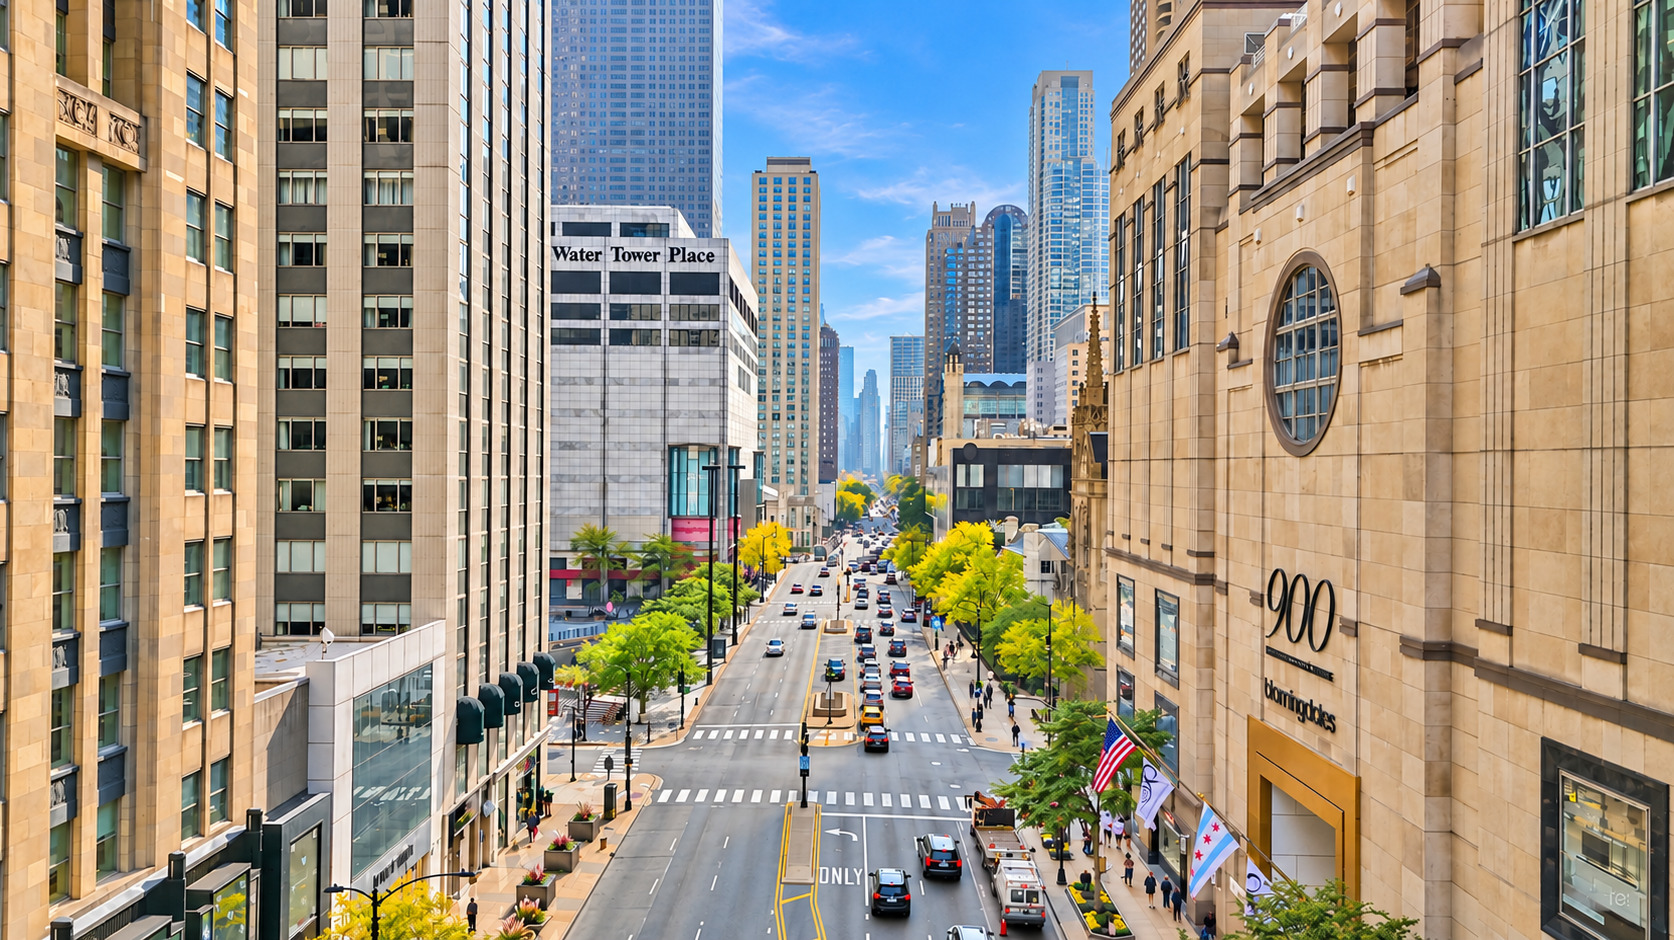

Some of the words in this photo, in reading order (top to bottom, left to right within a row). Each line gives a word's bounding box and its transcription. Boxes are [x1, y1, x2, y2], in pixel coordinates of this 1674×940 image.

[551, 246, 602, 262] Water
[610, 246, 660, 263] Tower
[668, 246, 715, 263] Place
[1265, 568, 1335, 652] 900
[819, 866, 863, 886] ONLY
